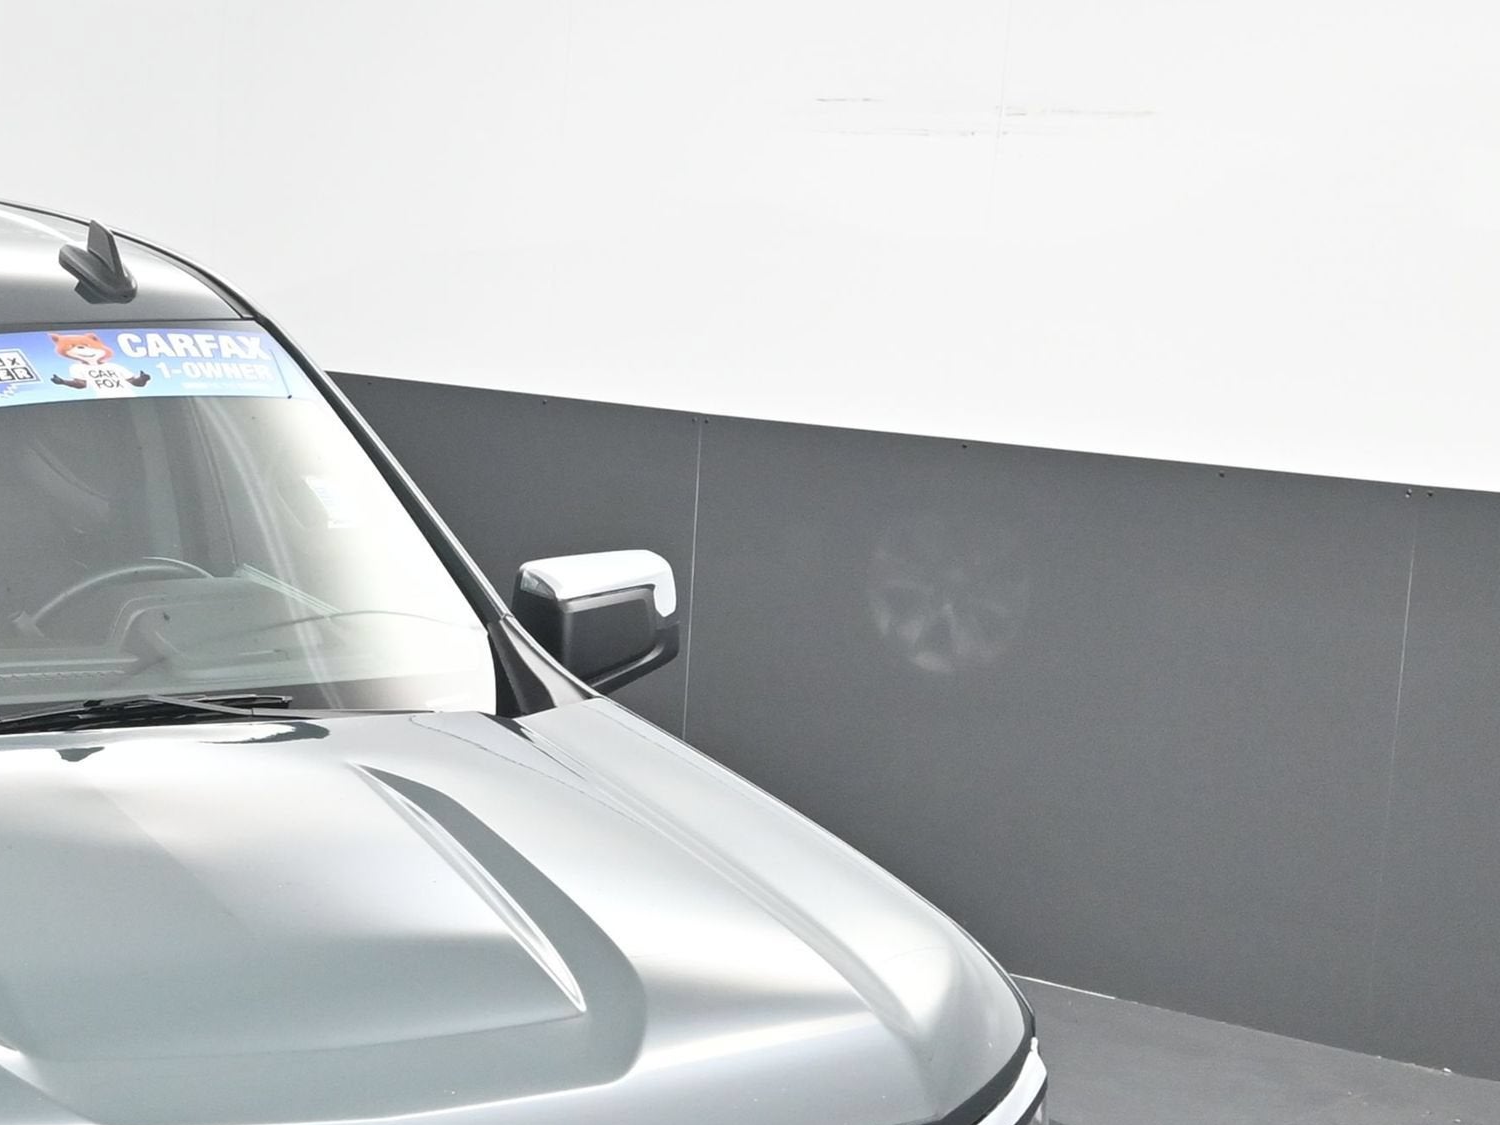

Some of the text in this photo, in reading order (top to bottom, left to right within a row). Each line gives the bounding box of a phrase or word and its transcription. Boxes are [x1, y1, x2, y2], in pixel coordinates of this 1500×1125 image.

[117, 333, 273, 361] CARFAX
[88, 369, 118, 379] CAR
[156, 361, 275, 381] 1-OWNER
[94, 378, 124, 389] FOX
